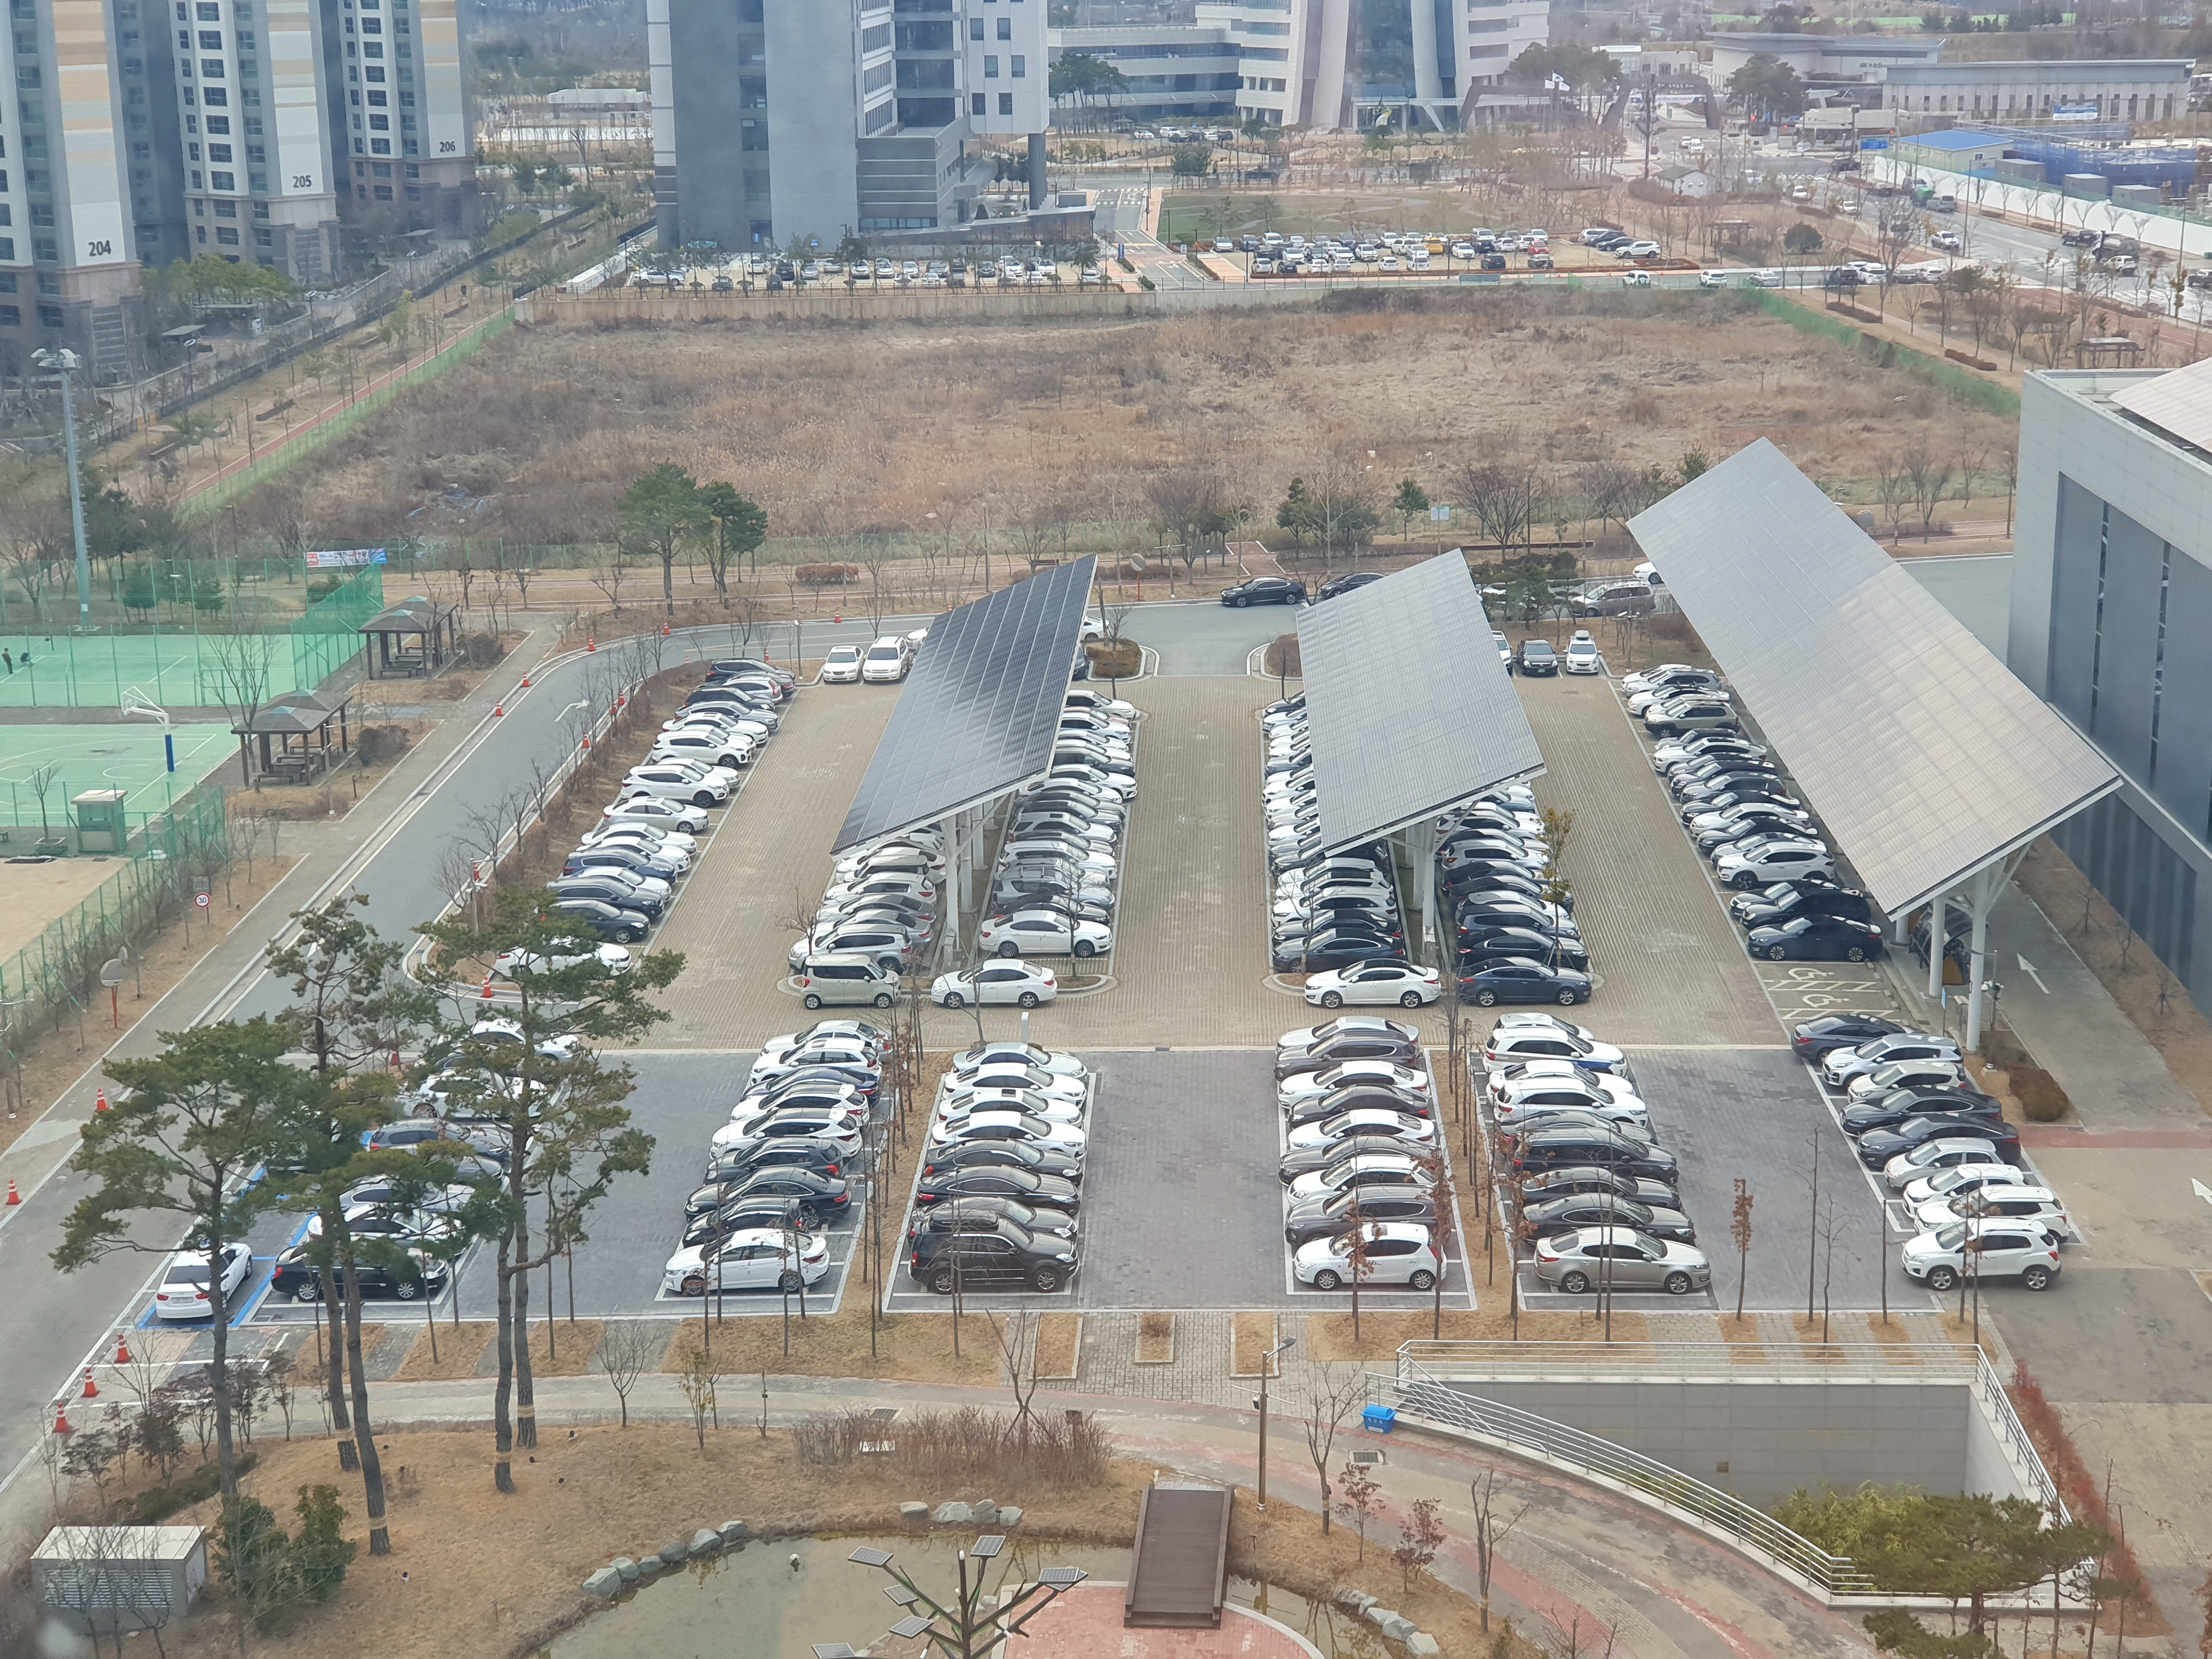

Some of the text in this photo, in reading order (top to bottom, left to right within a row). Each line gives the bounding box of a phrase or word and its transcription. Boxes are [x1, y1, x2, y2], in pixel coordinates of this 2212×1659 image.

[439, 141, 456, 153] 206
[292, 175, 312, 188] 205
[88, 240, 112, 256] 204
